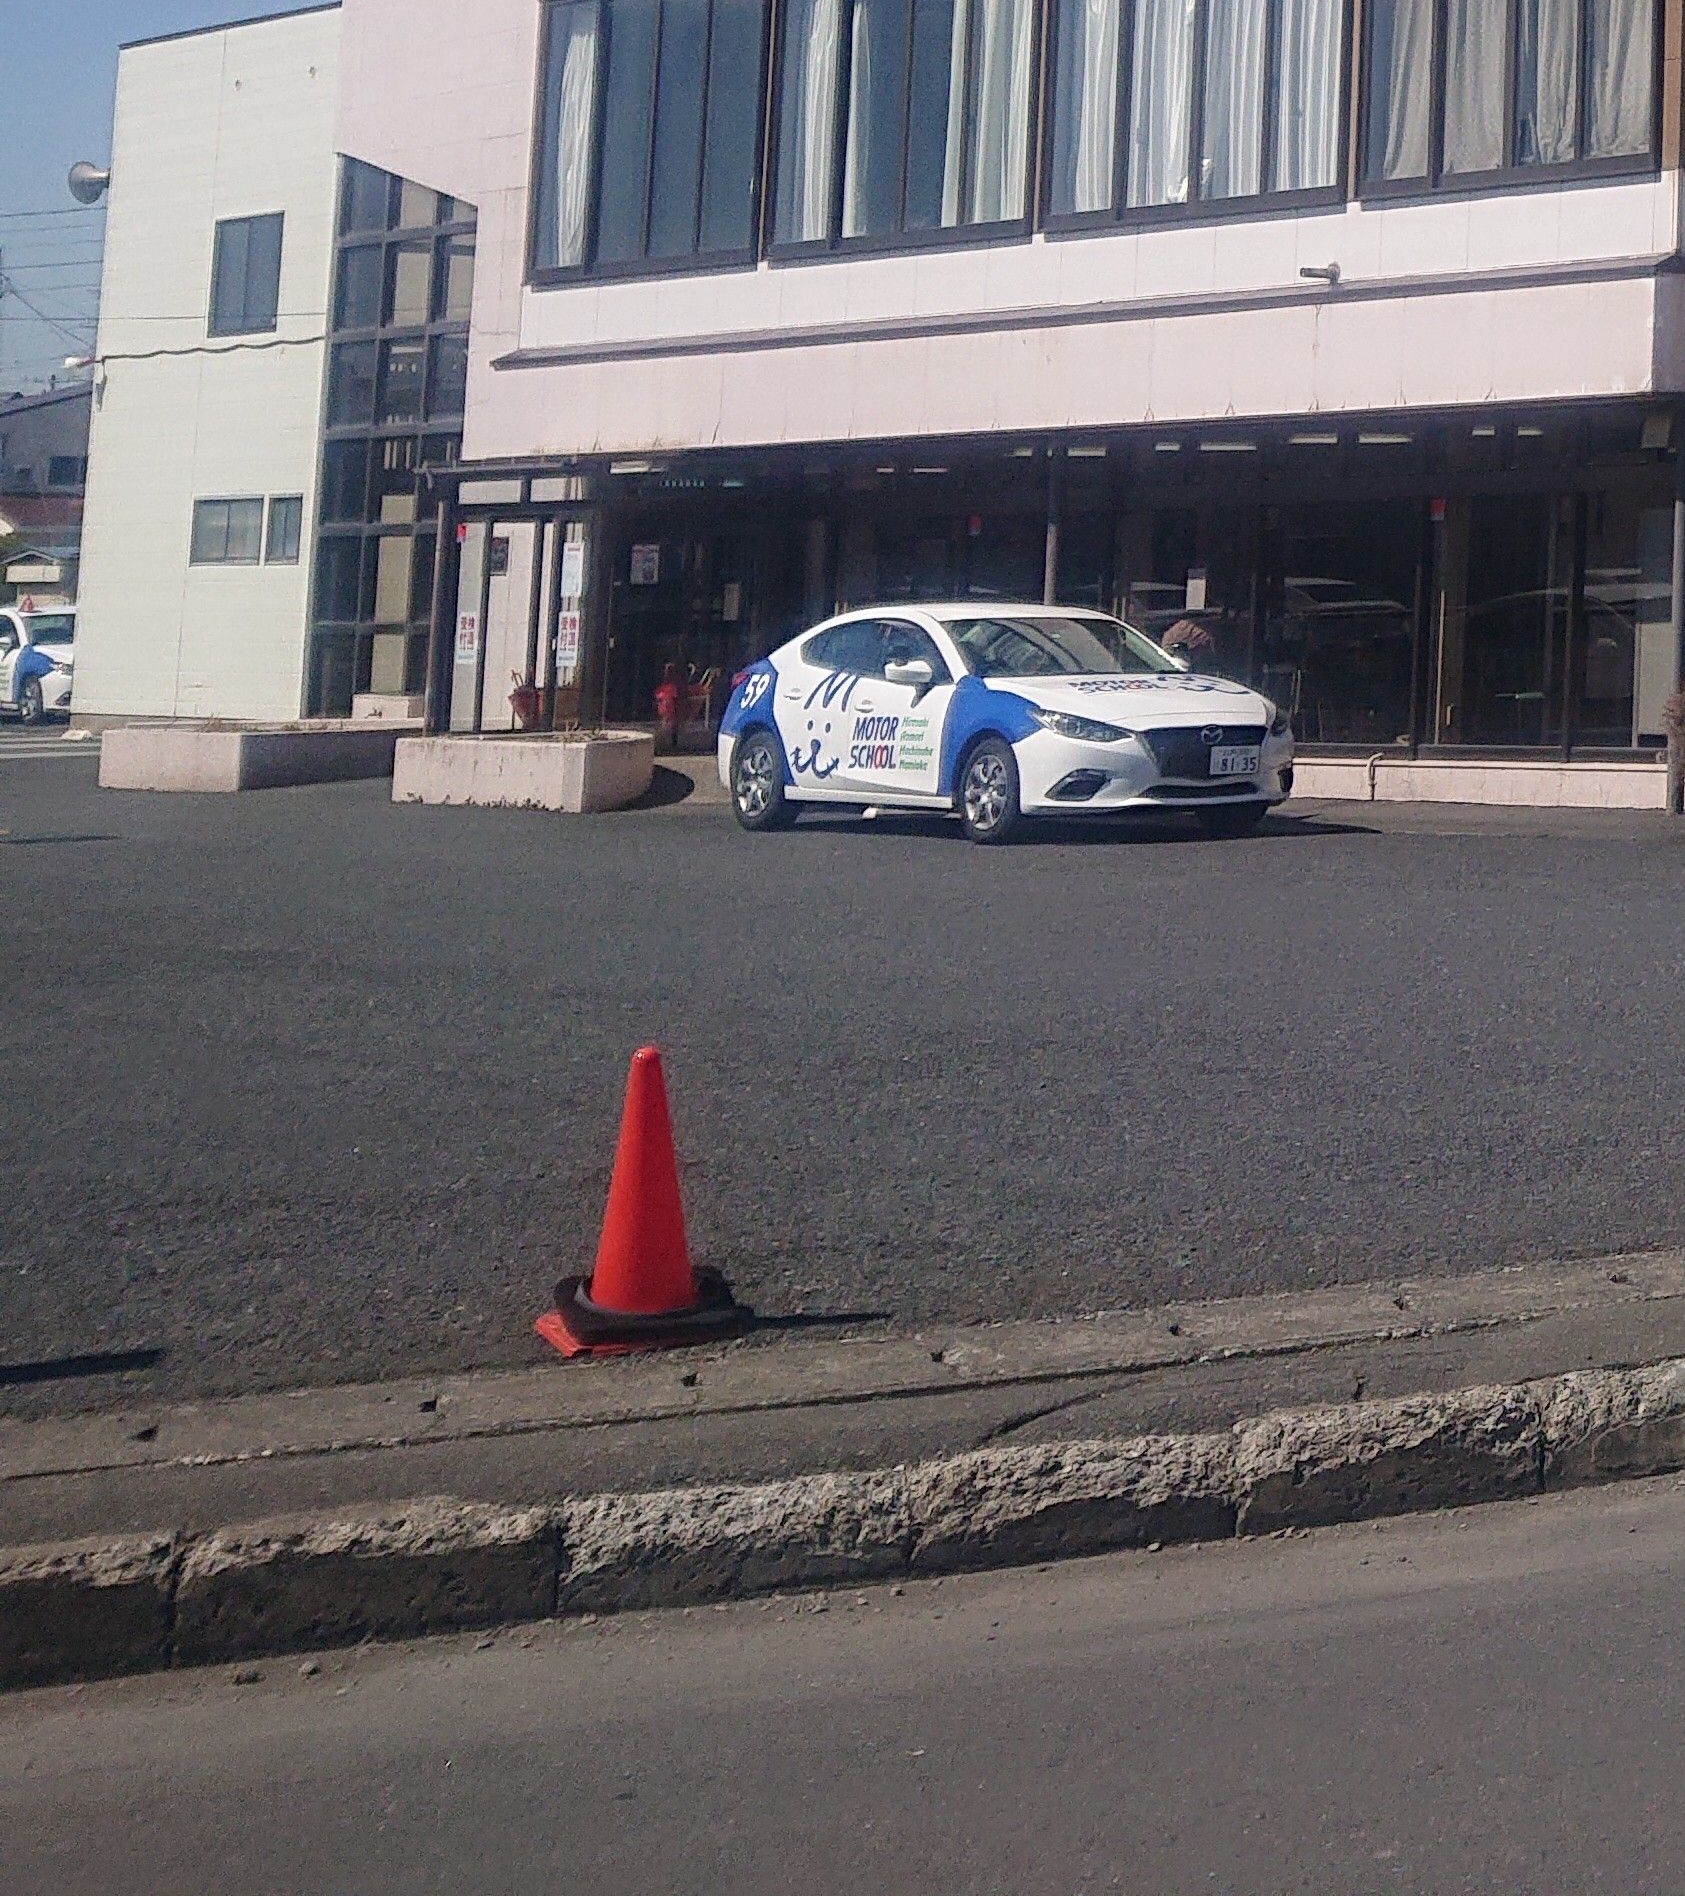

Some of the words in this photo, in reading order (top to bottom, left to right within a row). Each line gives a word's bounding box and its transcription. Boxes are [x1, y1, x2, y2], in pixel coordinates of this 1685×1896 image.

[741, 673, 770, 709] 59
[852, 716, 899, 741] MOTOR
[848, 745, 896, 769] SCHOOL
